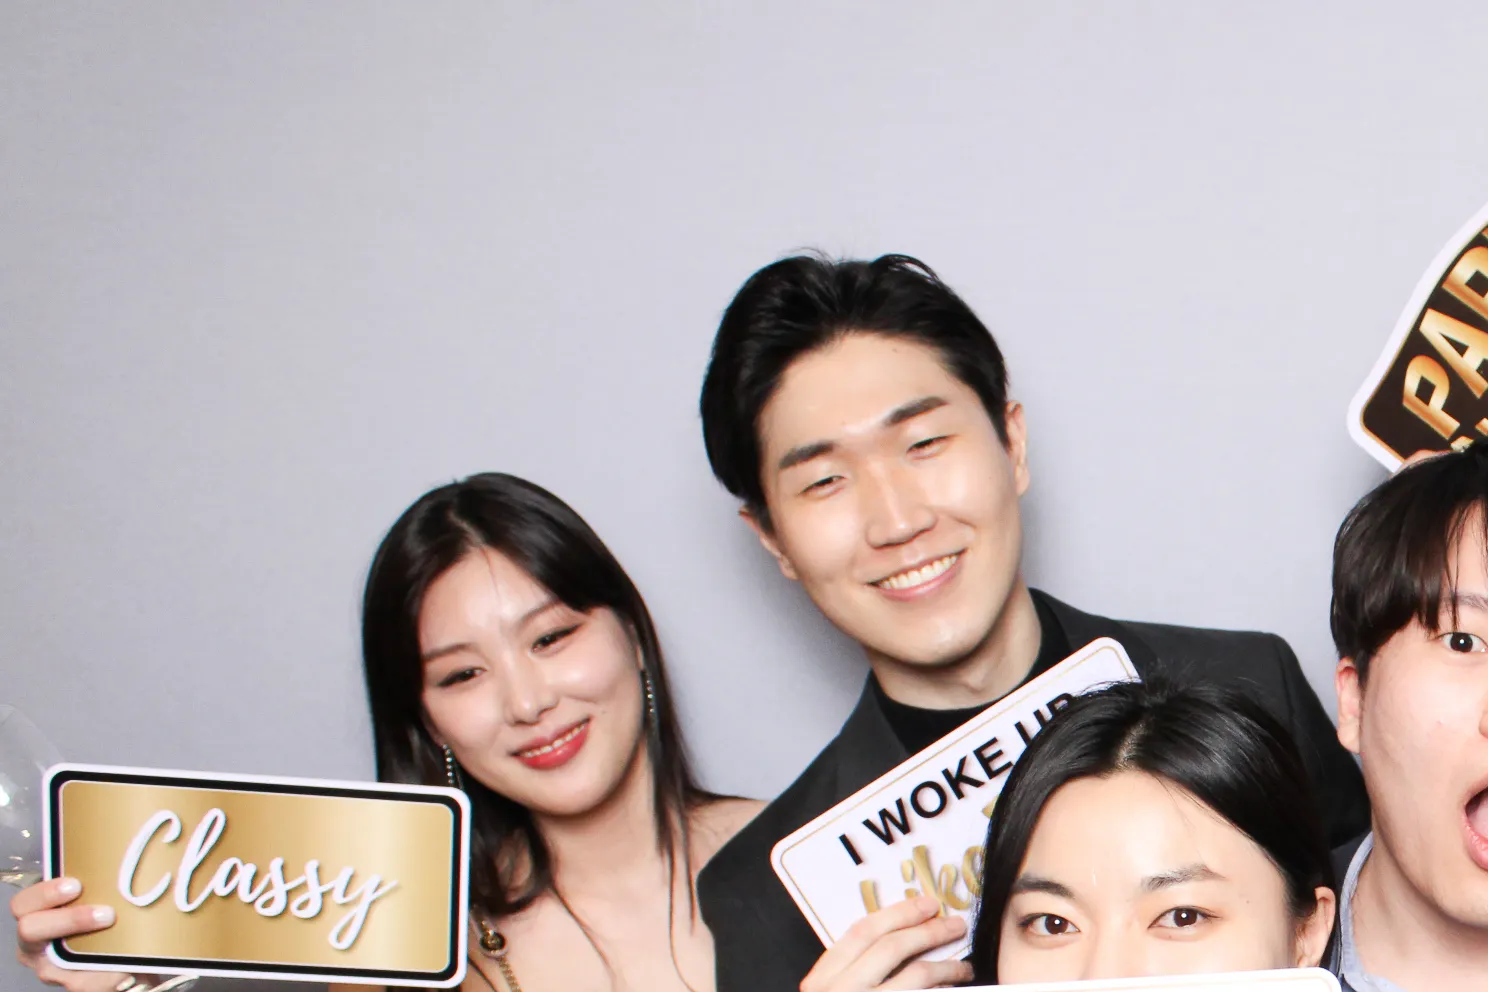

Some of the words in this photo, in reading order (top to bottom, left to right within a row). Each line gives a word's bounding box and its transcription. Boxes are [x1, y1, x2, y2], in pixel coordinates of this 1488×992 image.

[839, 834, 864, 866] I
[862, 737, 1013, 845] WOKE
[118, 807, 400, 951] Classy
